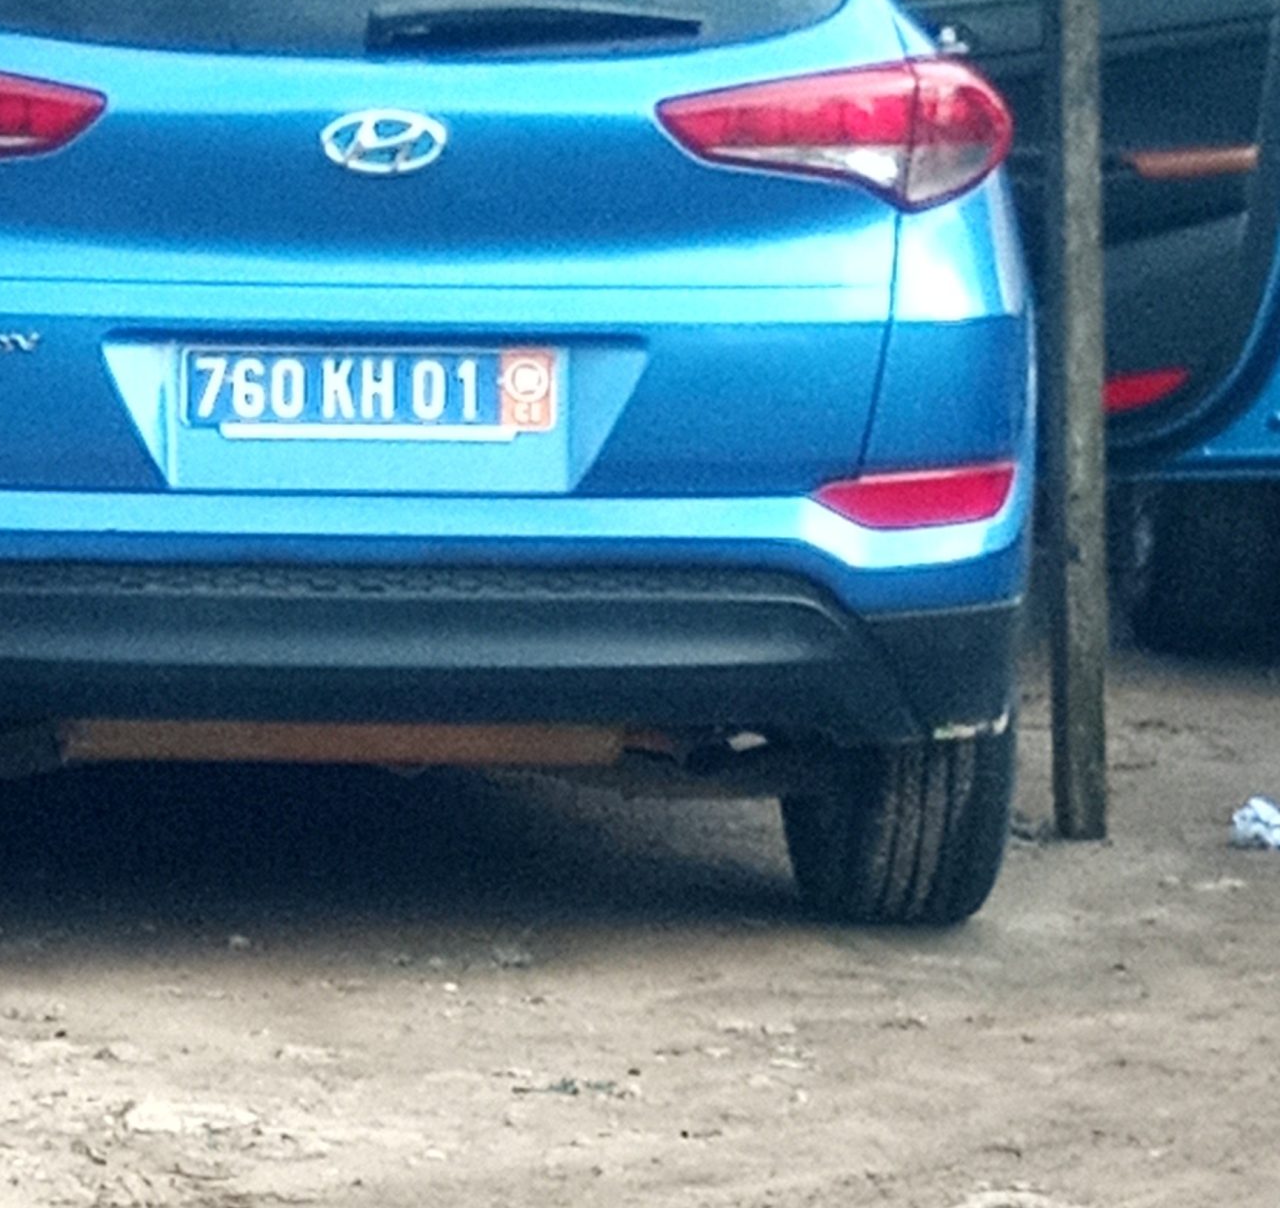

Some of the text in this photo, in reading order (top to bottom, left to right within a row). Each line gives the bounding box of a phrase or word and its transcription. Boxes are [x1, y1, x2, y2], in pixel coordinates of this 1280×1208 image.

[195, 356, 480, 423] 760 KH 01
